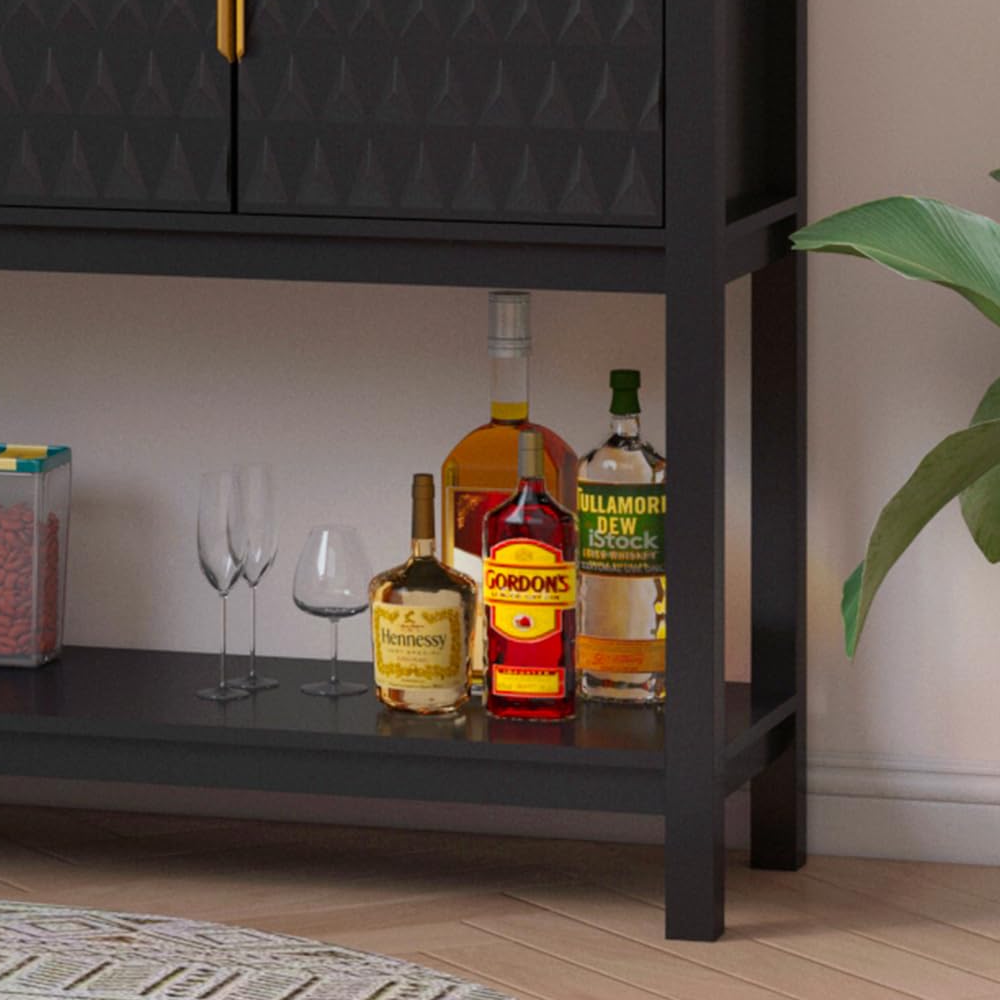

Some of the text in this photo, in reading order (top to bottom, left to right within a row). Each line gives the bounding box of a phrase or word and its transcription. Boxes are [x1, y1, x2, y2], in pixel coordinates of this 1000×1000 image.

[597, 516, 637, 536] DEW
[486, 569, 570, 593] GORDON'S
[382, 627, 447, 650] Hennessy
